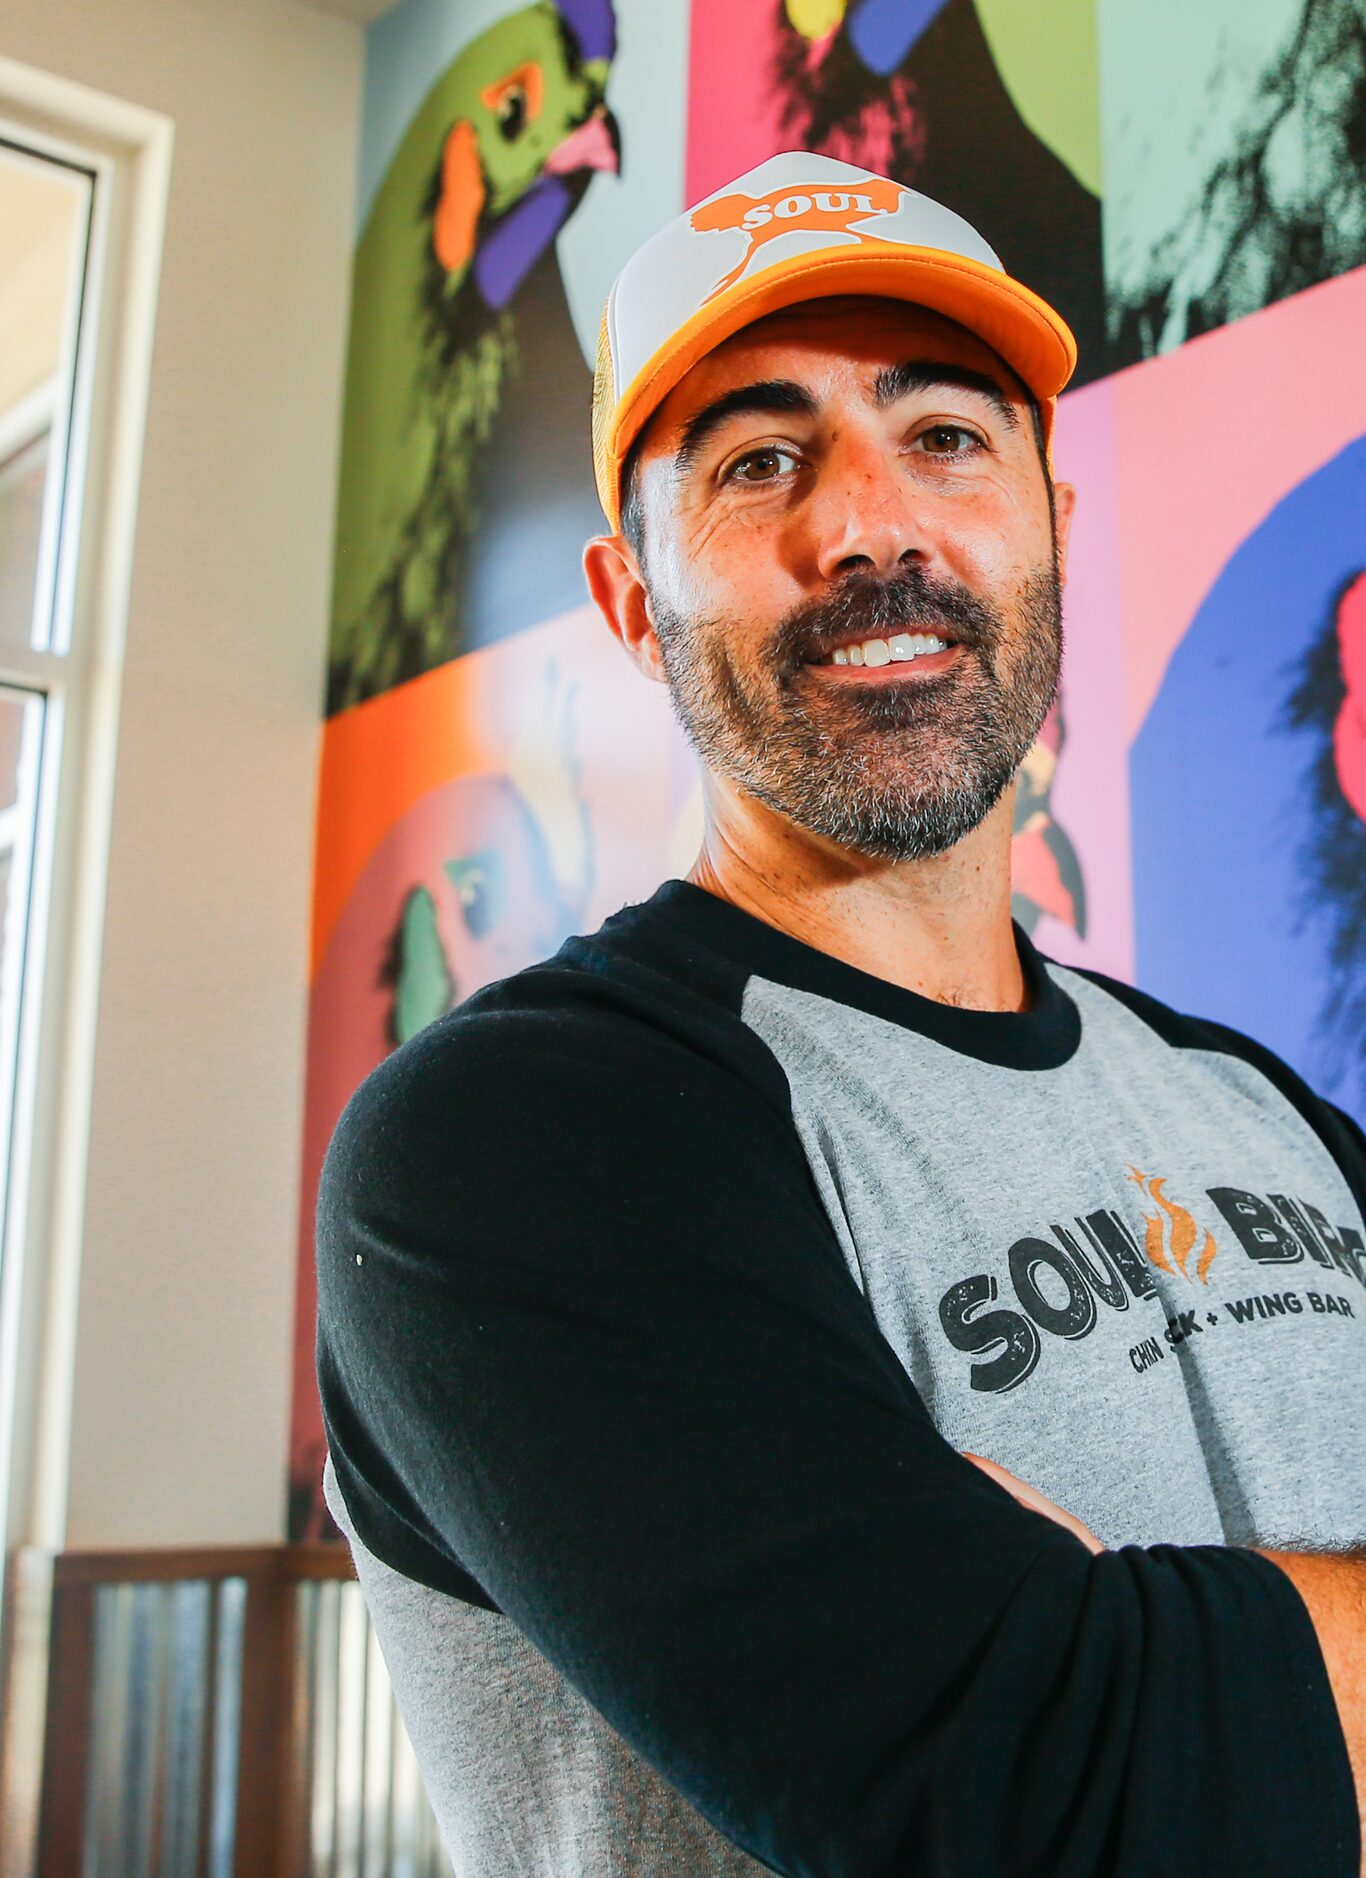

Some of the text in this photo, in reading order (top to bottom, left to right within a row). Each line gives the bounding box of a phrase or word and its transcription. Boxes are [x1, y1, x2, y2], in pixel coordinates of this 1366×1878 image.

[741, 193, 888, 230] SOUL
[939, 1209, 1161, 1395] SOUL
[1224, 1292, 1304, 1324] WING
[1306, 1292, 1356, 1319] BAR
